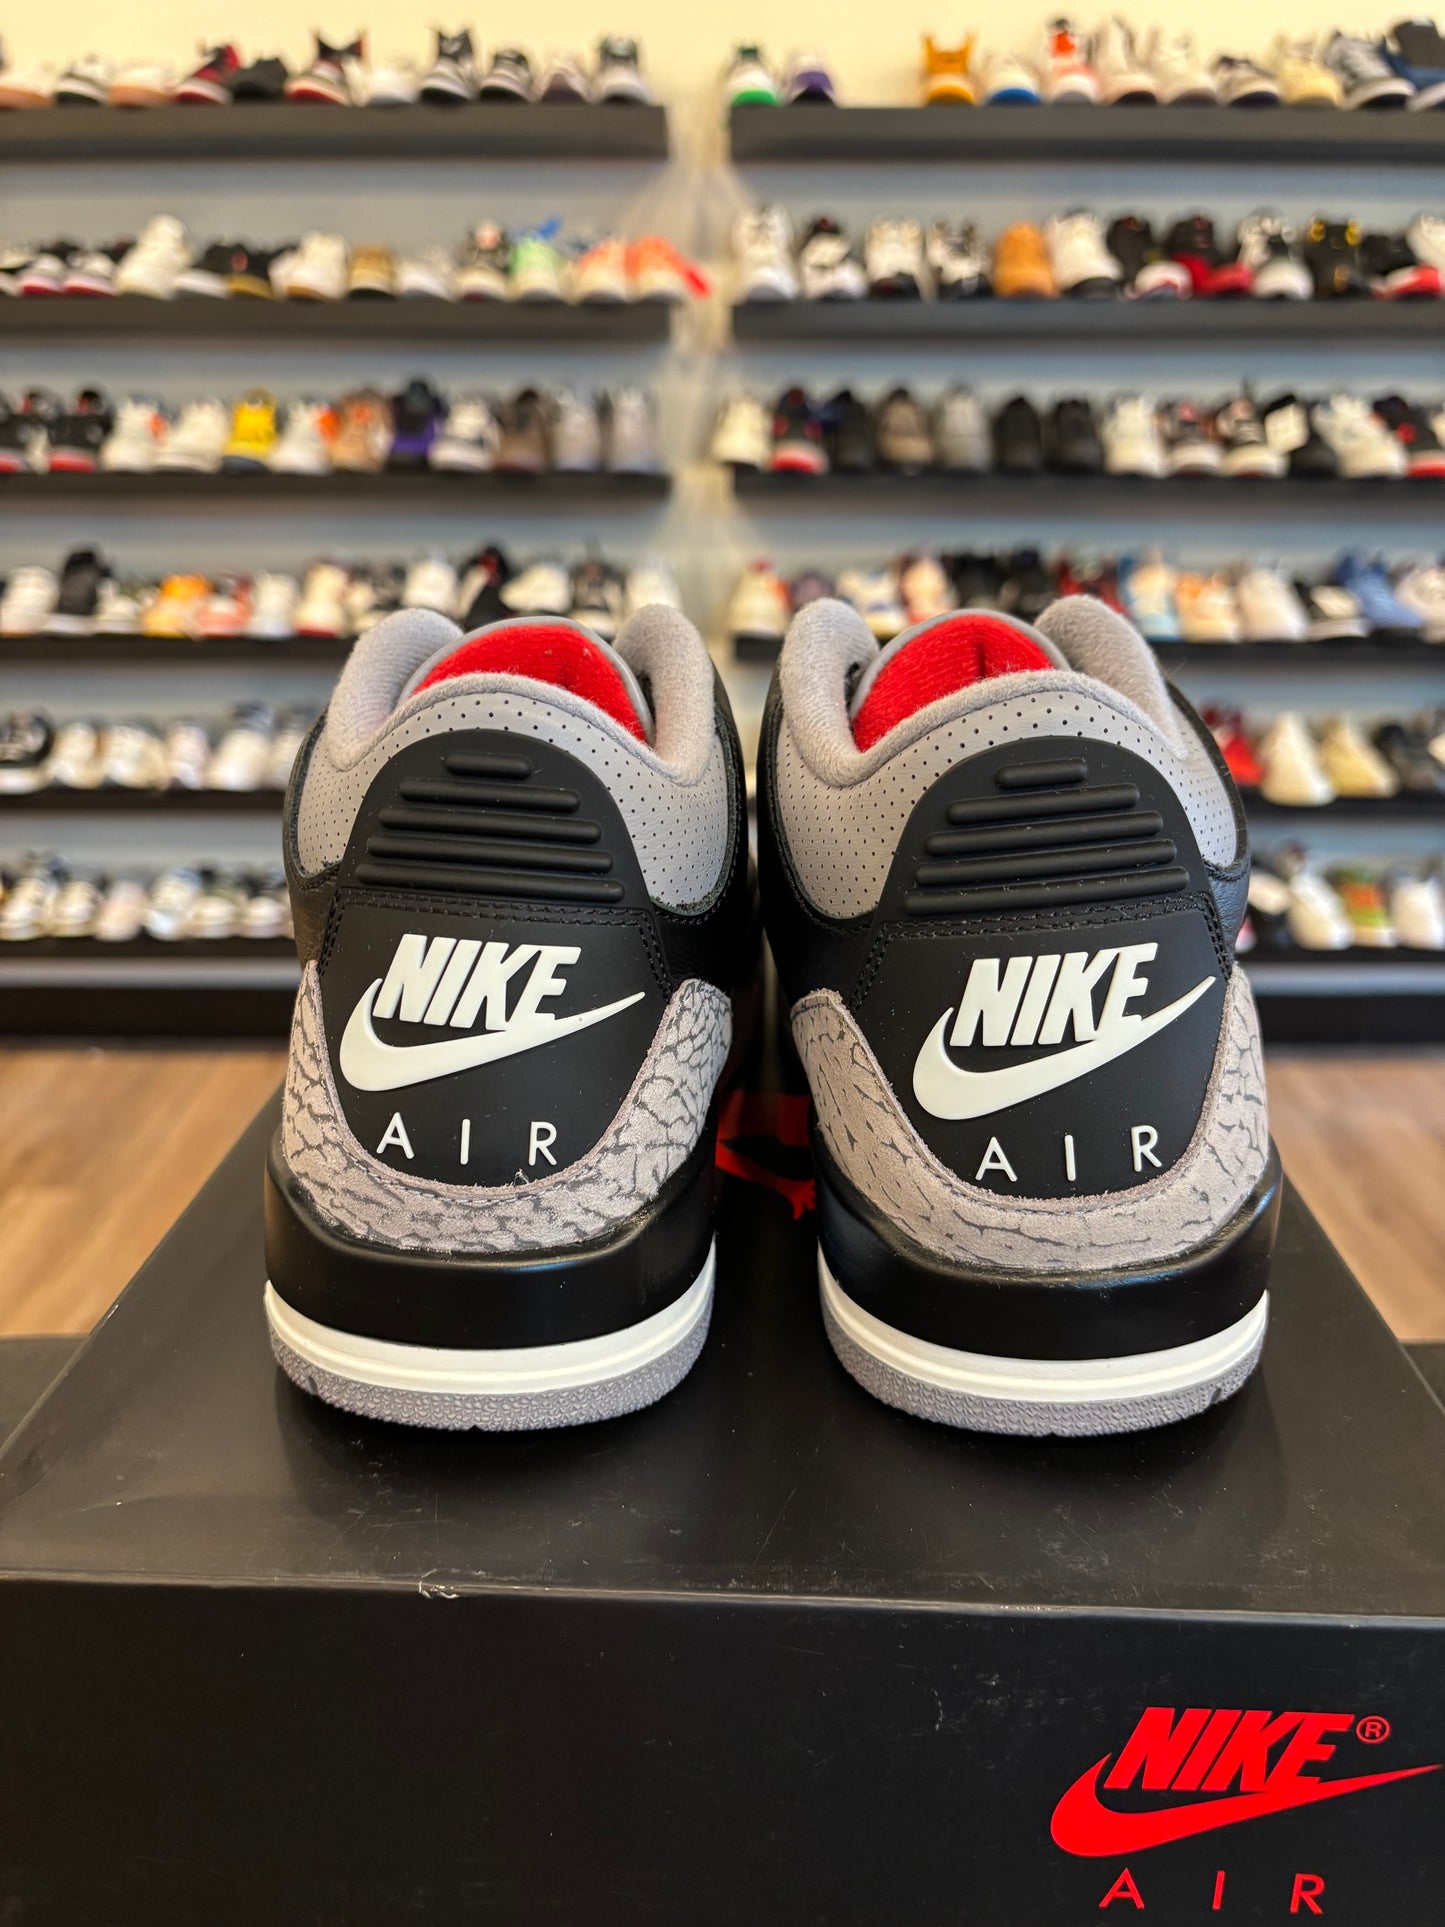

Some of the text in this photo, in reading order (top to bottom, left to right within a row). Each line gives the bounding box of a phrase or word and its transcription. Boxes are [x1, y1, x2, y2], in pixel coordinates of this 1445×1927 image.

[373, 933, 582, 1031] NIKE
[949, 942, 1158, 1047] NIKE
[376, 1111, 557, 1166] AIR
[975, 1125, 1162, 1182] AIR
[1099, 1867, 1325, 1915] AIR
